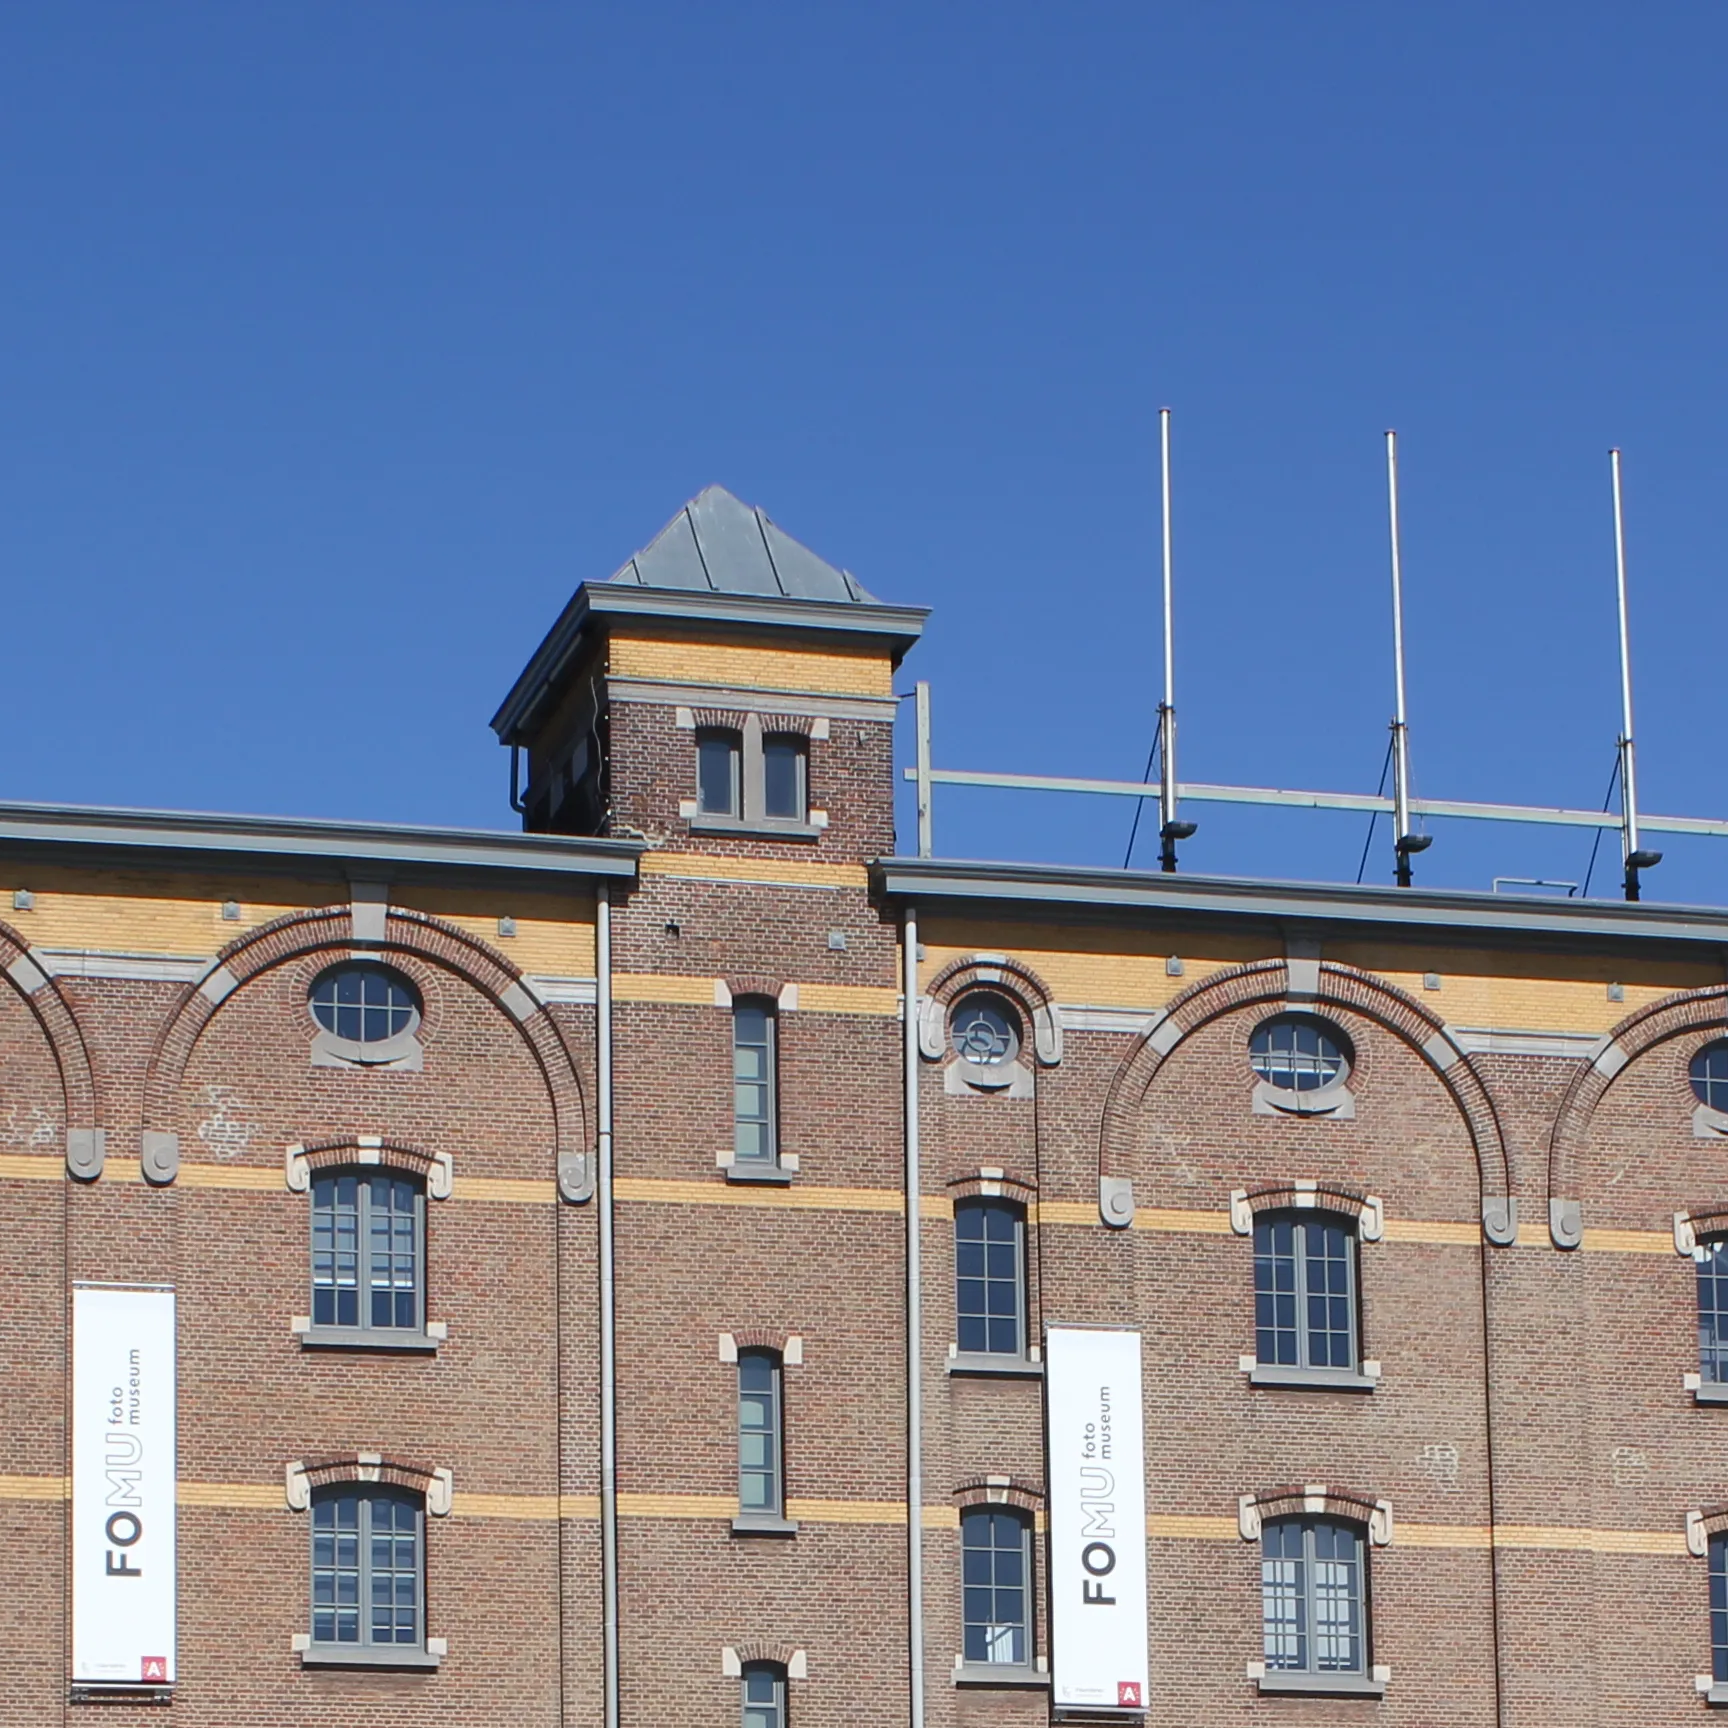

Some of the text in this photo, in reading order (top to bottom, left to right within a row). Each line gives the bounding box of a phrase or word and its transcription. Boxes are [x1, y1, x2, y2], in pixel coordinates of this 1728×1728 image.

[107, 1386, 124, 1425] foto
[128, 1348, 141, 1426] museum
[1100, 1386, 1112, 1460] museum
[1081, 1421, 1095, 1460] foto
[104, 1432, 144, 1577] FOMU
[1080, 1466, 1117, 1606] FOMU
